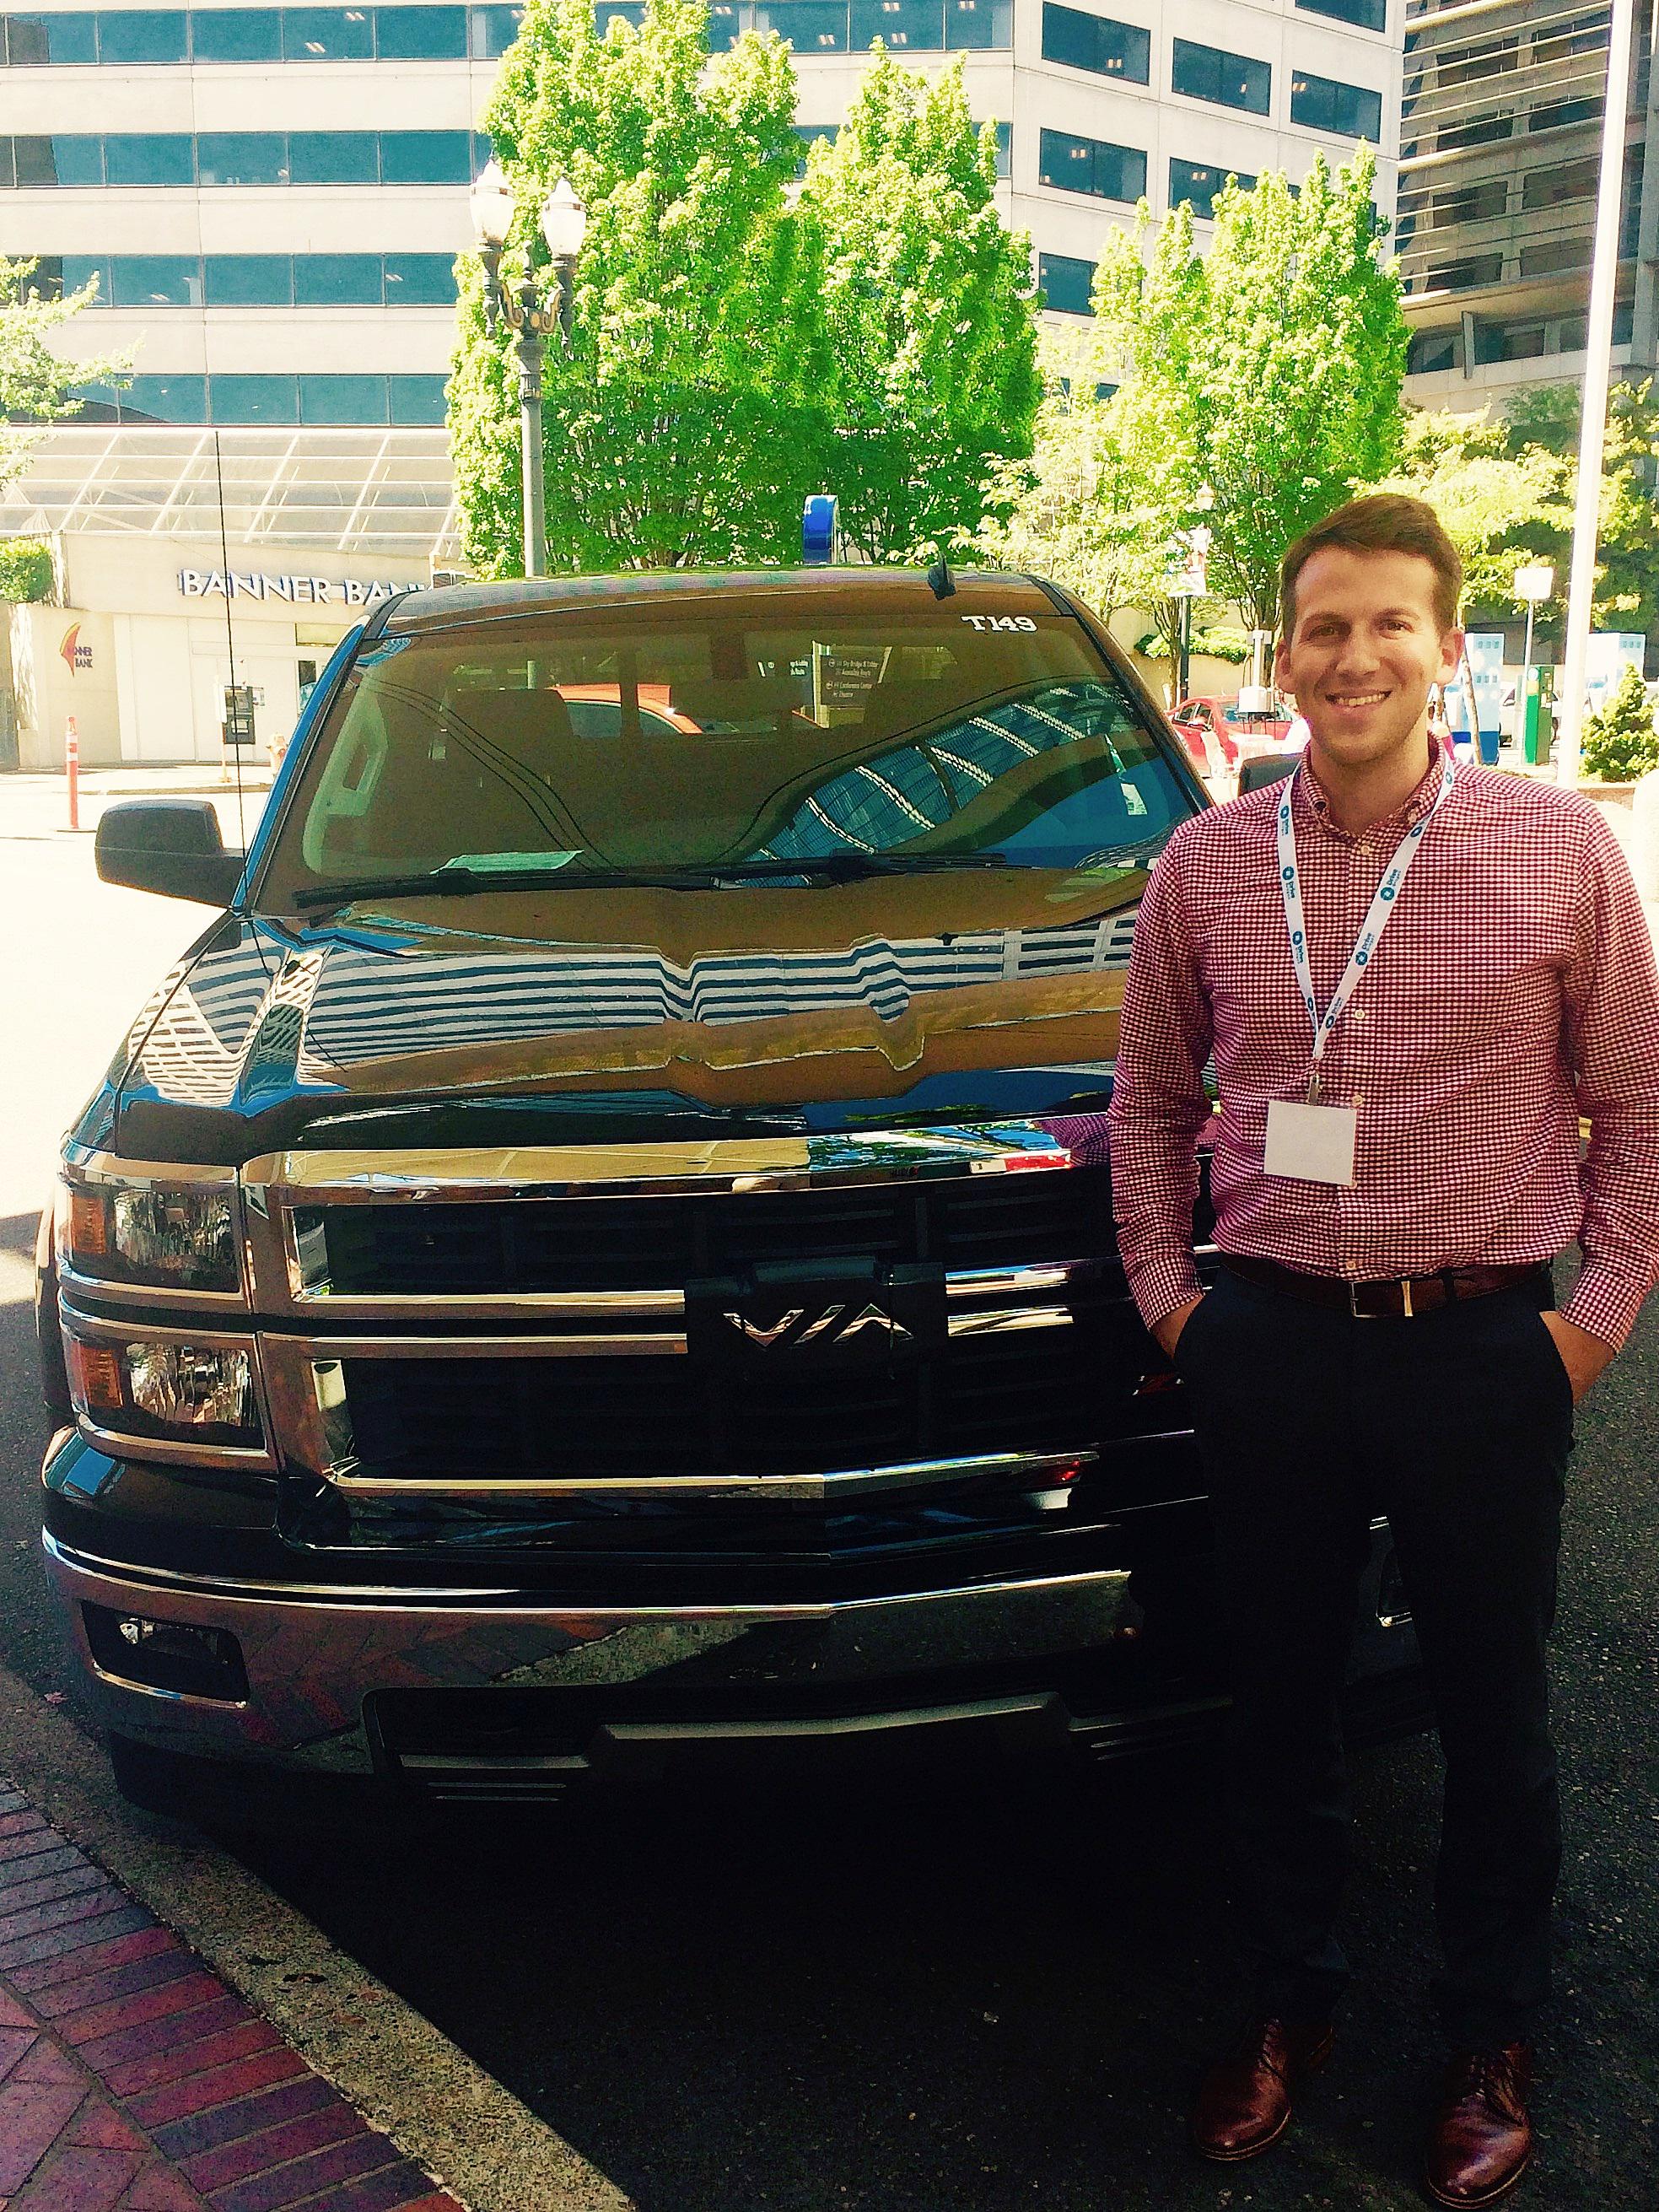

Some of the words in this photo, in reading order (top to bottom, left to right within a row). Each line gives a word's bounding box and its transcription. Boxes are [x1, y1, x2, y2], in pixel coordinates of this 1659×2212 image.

[180, 569, 332, 604] BANNER
[344, 579, 425, 606] BA
[961, 615, 1037, 633] T149
[722, 1303, 915, 1347] VIA
